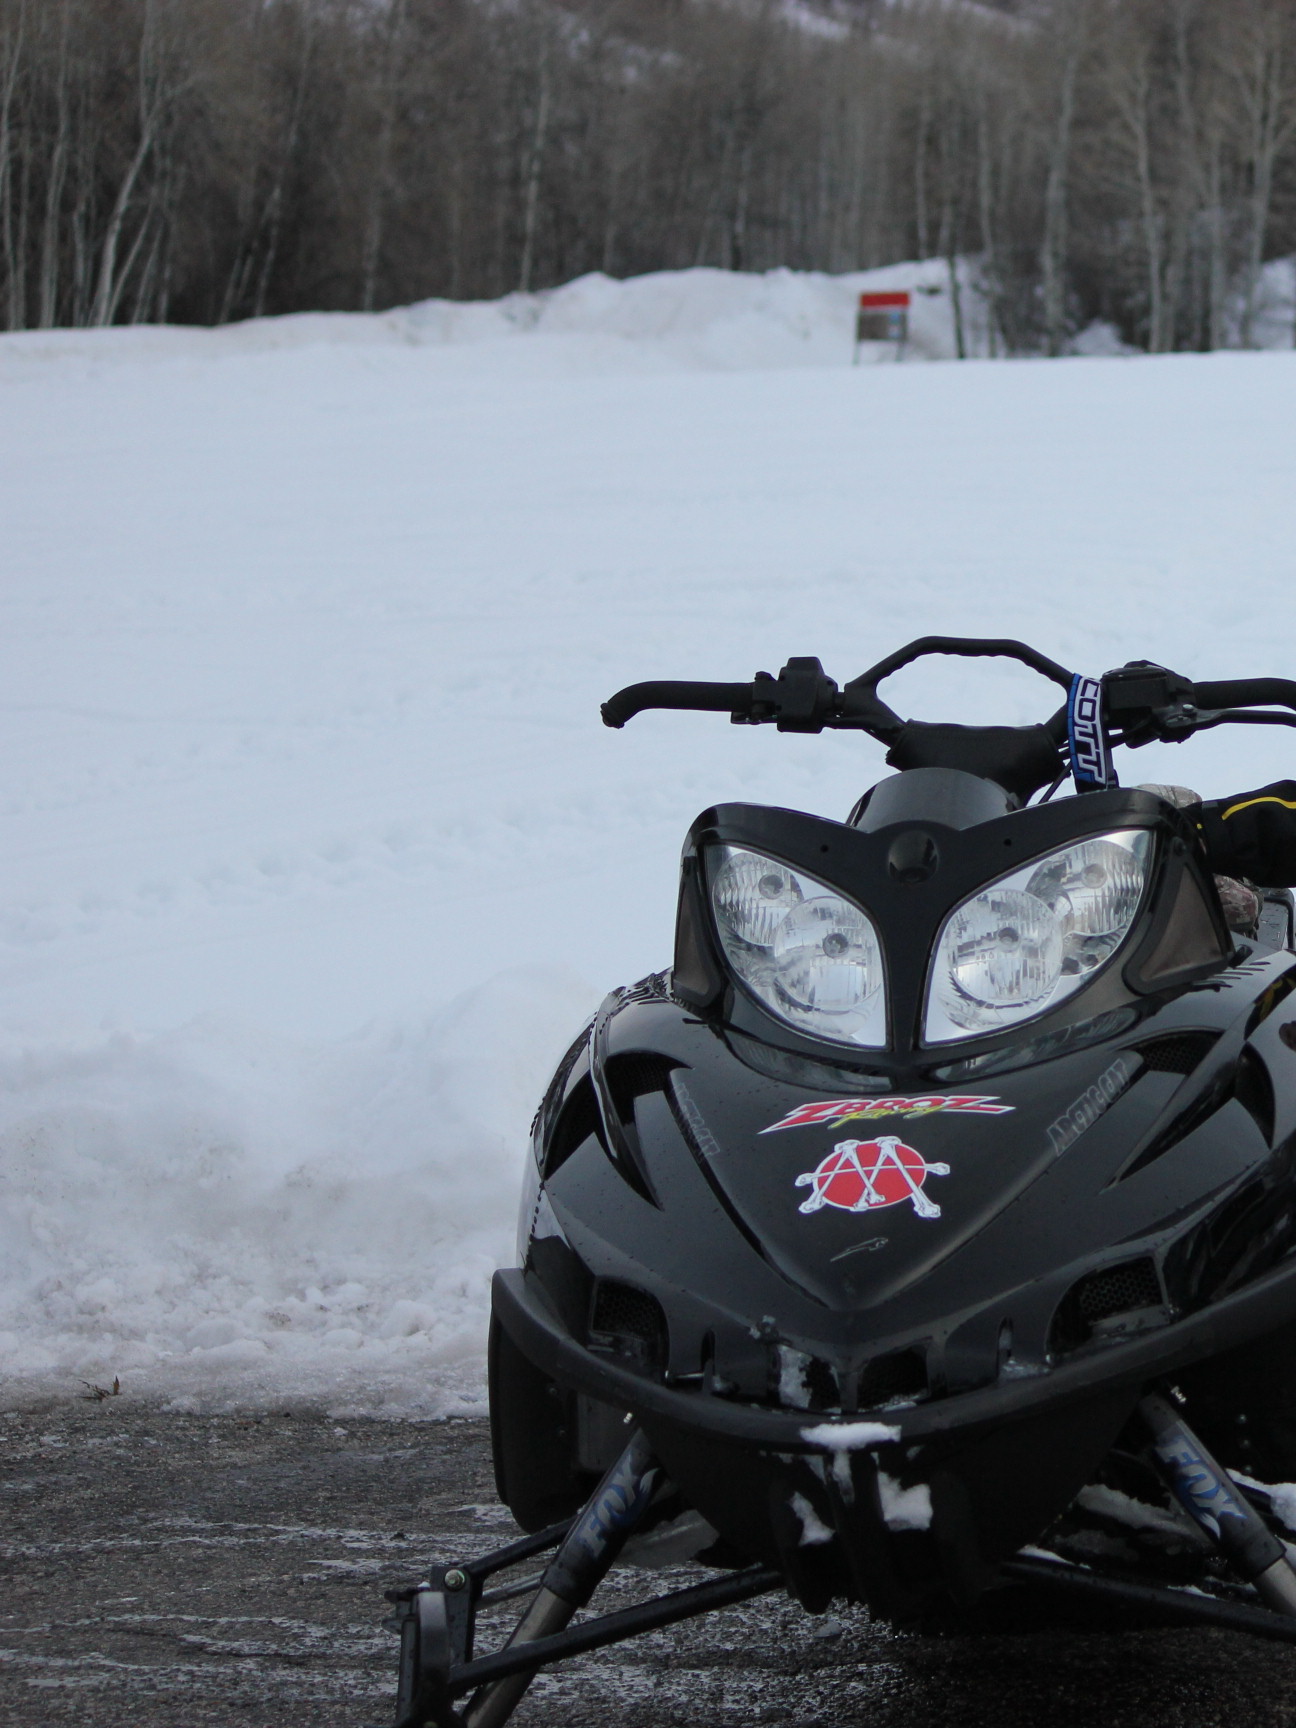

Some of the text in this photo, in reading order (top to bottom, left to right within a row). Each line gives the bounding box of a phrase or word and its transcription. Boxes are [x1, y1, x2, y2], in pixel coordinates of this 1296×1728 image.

[757, 1095, 1016, 1134] ZBROZ
[578, 1454, 640, 1557] FOX
[1154, 1437, 1247, 1519] FOX
